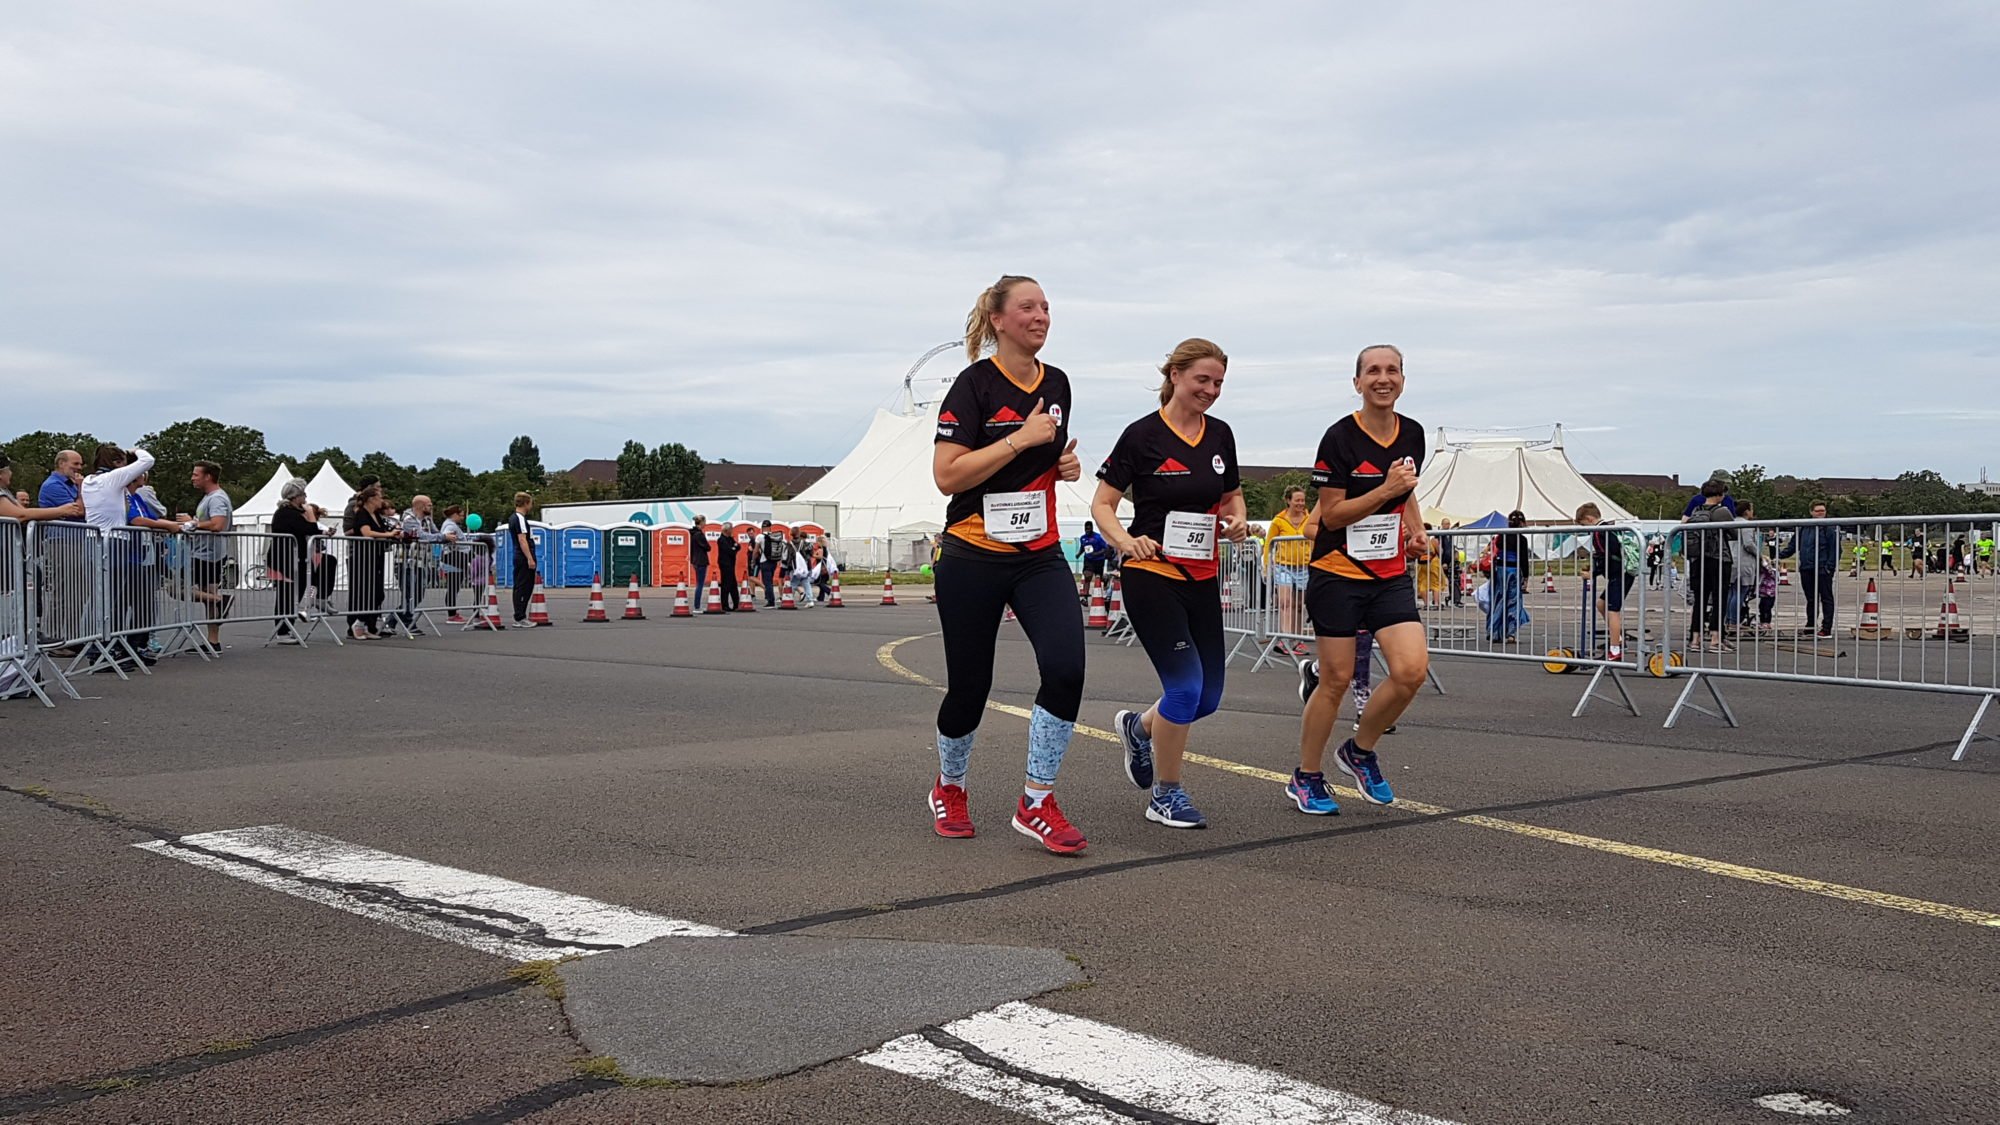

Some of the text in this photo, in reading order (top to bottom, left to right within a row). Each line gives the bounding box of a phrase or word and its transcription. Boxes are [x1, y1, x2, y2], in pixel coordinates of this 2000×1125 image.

[1010, 512, 1031, 525] 514
[1187, 531, 1205, 544] 513
[1370, 533, 1388, 545] 516
